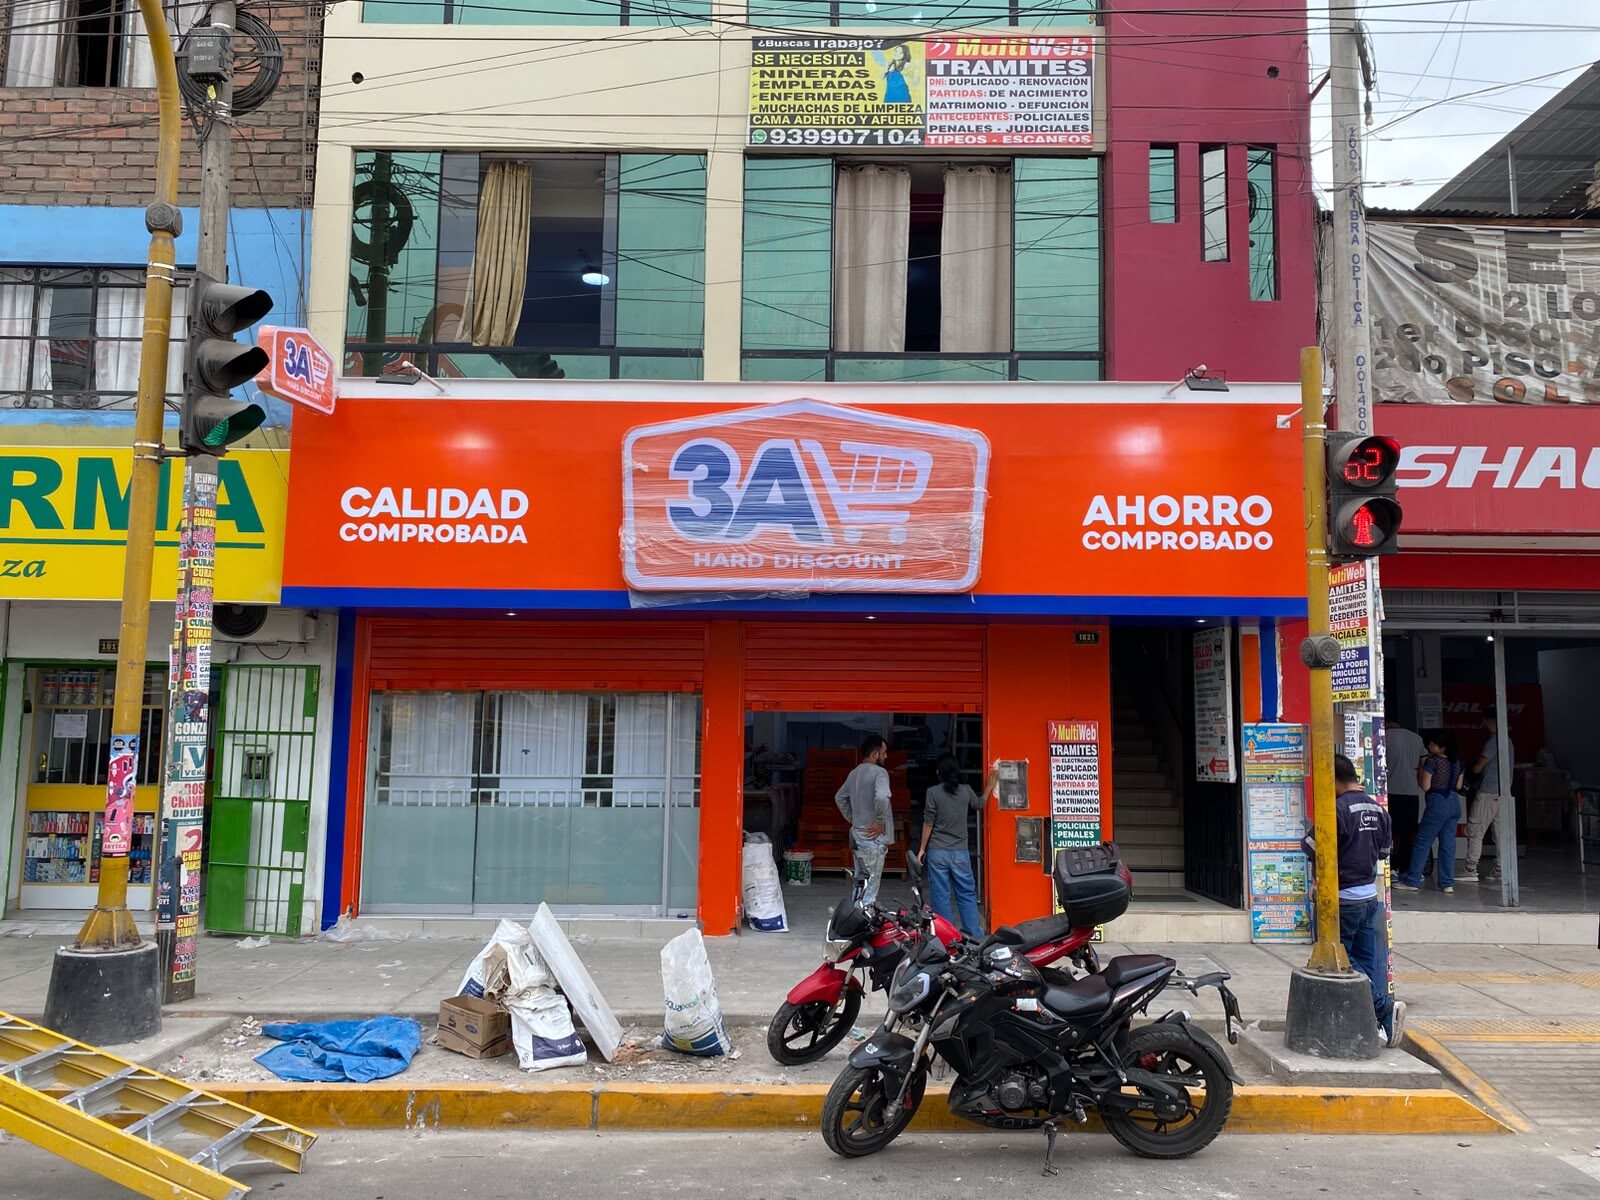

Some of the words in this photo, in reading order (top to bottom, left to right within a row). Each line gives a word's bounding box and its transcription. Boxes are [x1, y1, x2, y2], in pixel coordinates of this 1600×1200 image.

[814, 39, 885, 51] Trabajo?
[955, 38, 1090, 57] MultiWeb
[753, 54, 774, 65] SE
[779, 54, 863, 65] NECESITA:
[759, 68, 870, 79] NIÑERAS
[931, 60, 1087, 76] TRAMITES
[759, 80, 876, 89] EMPLEADAS
[949, 78, 1010, 86] DUPLICADO
[1019, 76, 1088, 86] RENOVACIÓN
[759, 92, 878, 101] ENFERMERAS
[929, 90, 987, 98] PARTIDAS:
[1009, 90, 1088, 98] NACIMIENTO
[758, 104, 839, 113] MUCHACHAS
[843, 104, 860, 113] DE
[864, 104, 923, 113] LIMPIEZA
[1018, 100, 1089, 109] DEFUNCIÓN
[752, 115, 791, 125] CAMA
[794, 115, 856, 125] ADENTRO
[857, 115, 868, 124] Y
[871, 115, 923, 125] AFUERA
[929, 112, 1013, 121] ANTECEDENTES:
[1014, 113, 1090, 121] POLICIALES
[929, 125, 993, 133] PENALES
[1005, 125, 1090, 133] JUDICIALES
[769, 128, 921, 145] 939907104
[927, 135, 988, 144] TIPEOS
[1351, 253, 1363, 325] OPTICA
[284, 337, 312, 387] 3A
[1394, 445, 1600, 489] SHA
[665, 438, 834, 545] 3A
[340, 487, 529, 519] CALIDAD
[1082, 495, 1273, 526] AHORRO
[339, 522, 528, 544] COMPROBADA
[1082, 531, 1273, 550] COMPROBADO
[694, 551, 766, 571] HARD
[774, 552, 906, 571] DISCOUNT
[1338, 600, 1367, 611] NACIMIENTO
[1346, 659, 1369, 669] PODER
[1058, 723, 1097, 741] MultiWeb
[1050, 744, 1098, 756] TRAMITES
[1057, 822, 1100, 830] POLICIALES
[1057, 830, 1094, 838] PENALES
